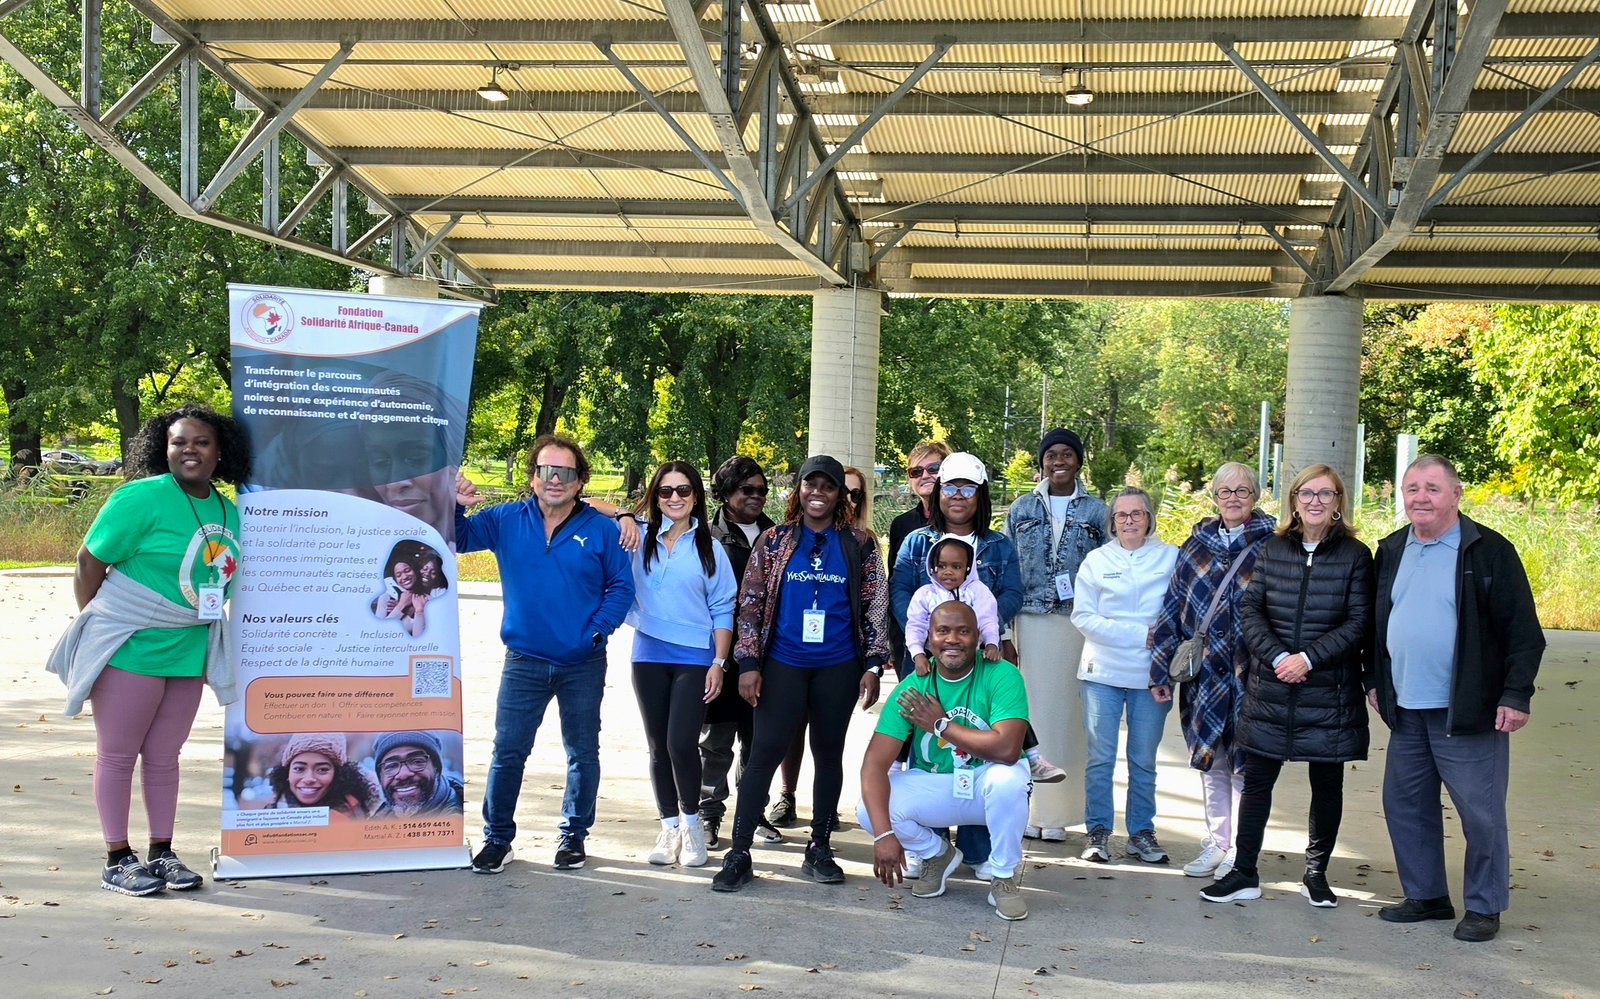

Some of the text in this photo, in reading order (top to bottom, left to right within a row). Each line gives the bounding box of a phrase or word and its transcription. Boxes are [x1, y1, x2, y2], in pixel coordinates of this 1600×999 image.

[338, 306, 384, 318] Fondation
[300, 316, 418, 334] Solidarité Afrique-Canada
[244, 366, 362, 382] Transformer le parcours
[244, 379, 400, 396] d'intégration des communautés
[244, 394, 274, 402] noires
[313, 397, 368, 408] expérience
[370, 400, 434, 411] d'autonomie,
[244, 406, 256, 415] de
[258, 408, 335, 419] reconnaissance
[350, 412, 420, 423] d'engagement
[422, 415, 449, 426] citoyen
[244, 506, 328, 518] Notre mission
[242, 522, 427, 538] Soutenir l'inclusion, la justice sociale
[255, 538, 264, 547] la
[267, 538, 316, 548] solidarité
[318, 541, 344, 550] pour
[346, 541, 361, 549] les
[242, 554, 297, 564] personnes
[300, 554, 365, 566] immigrantes
[242, 568, 380, 580] les communautés racisées,
[257, 583, 300, 592] Québec
[332, 584, 374, 594] Canada.
[242, 614, 339, 624] Nos valeurs clés
[241, 629, 290, 638] Solidarité
[293, 629, 337, 639] concrète
[360, 630, 404, 639] Inclusion
[241, 642, 274, 654] Équité
[277, 643, 313, 652] sociale
[335, 643, 370, 653] Justice
[373, 643, 439, 653] interculturelle
[241, 658, 394, 670] Respect de la dignité humaine
[374, 700, 423, 709] compétences
[264, 712, 306, 720] Contribuer
[376, 711, 409, 720] rayonner
